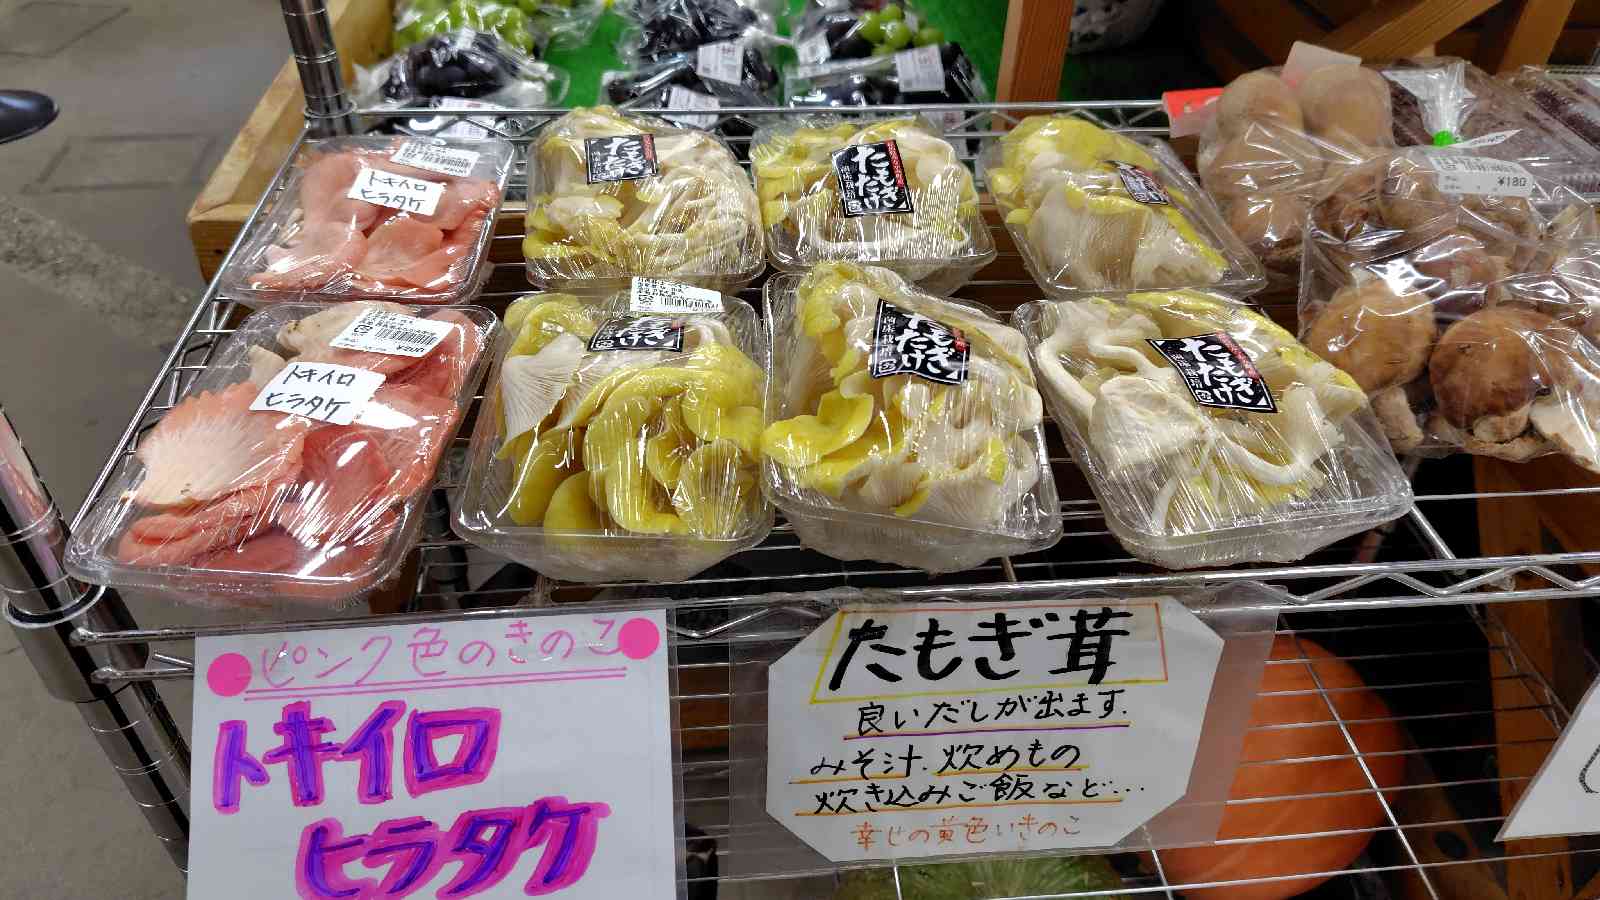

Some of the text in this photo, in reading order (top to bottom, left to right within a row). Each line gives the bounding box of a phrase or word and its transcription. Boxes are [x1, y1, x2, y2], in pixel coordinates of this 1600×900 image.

[367, 171, 428, 192] トキイロ
[1497, 176, 1528, 188] ¥180
[361, 188, 425, 212] ヒラタケ
[283, 364, 356, 386] トキイロ
[265, 392, 352, 420] ヒラタケ
[261, 618, 622, 688] ピンク色のきのこ
[829, 606, 1134, 691] たもぎ茸
[213, 699, 502, 814] トキイロ
[294, 796, 612, 900] ヒラタケ
